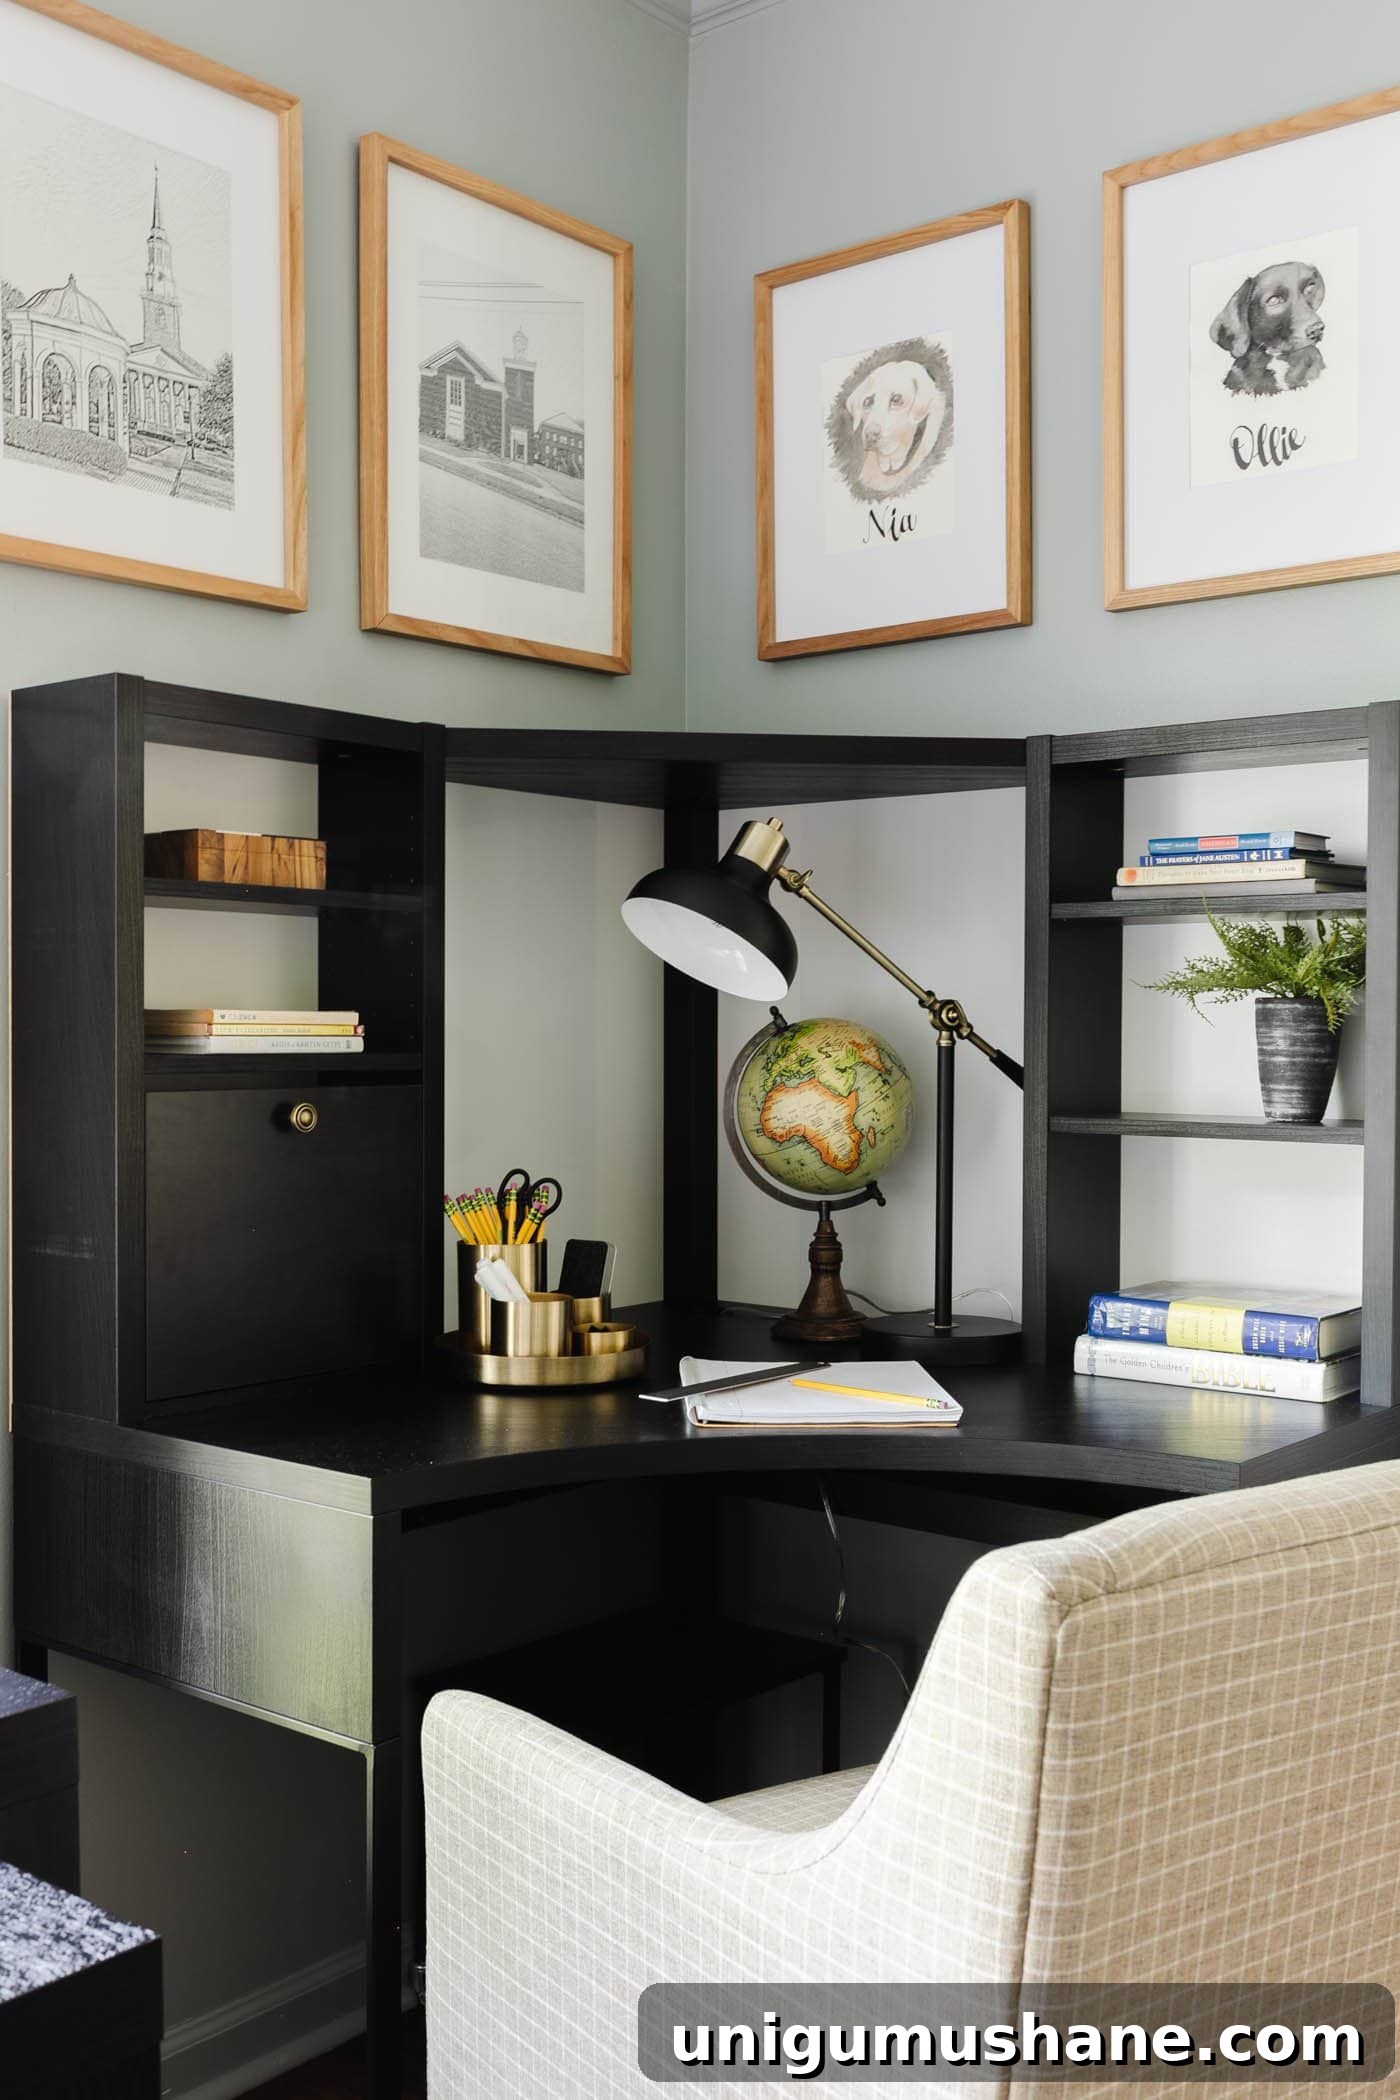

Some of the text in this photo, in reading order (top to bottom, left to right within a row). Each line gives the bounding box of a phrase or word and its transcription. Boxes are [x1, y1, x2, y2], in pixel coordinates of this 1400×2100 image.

[1230, 423, 1306, 469] Ollie
[863, 504, 917, 543] Nia
[1104, 1352, 1117, 1364] The
[1191, 1355, 1276, 1392] BIBLE
